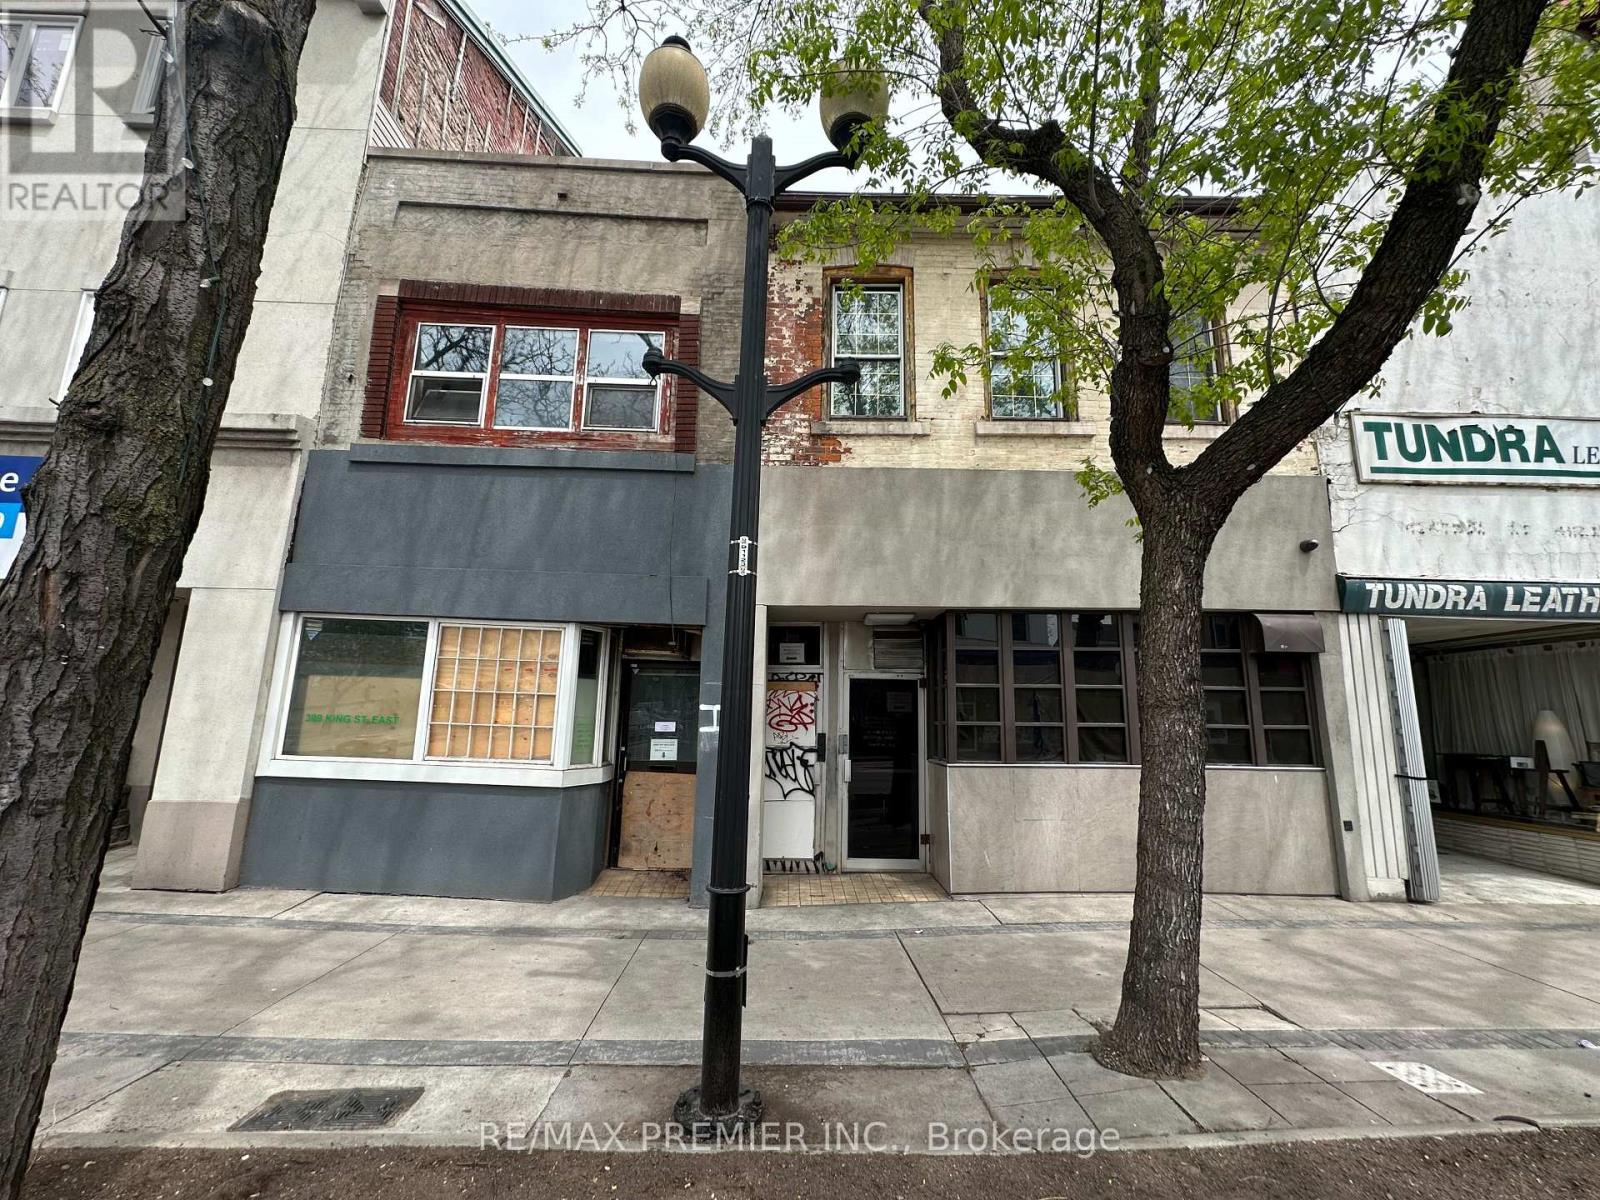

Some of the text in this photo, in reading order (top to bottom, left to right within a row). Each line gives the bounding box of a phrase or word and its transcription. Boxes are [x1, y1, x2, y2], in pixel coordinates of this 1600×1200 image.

[1363, 421, 1600, 465] TUNDRA LE
[1365, 582, 1600, 613] TUNDRA LEATH
[325, 714, 351, 724] KING
[371, 715, 400, 726] EAST
